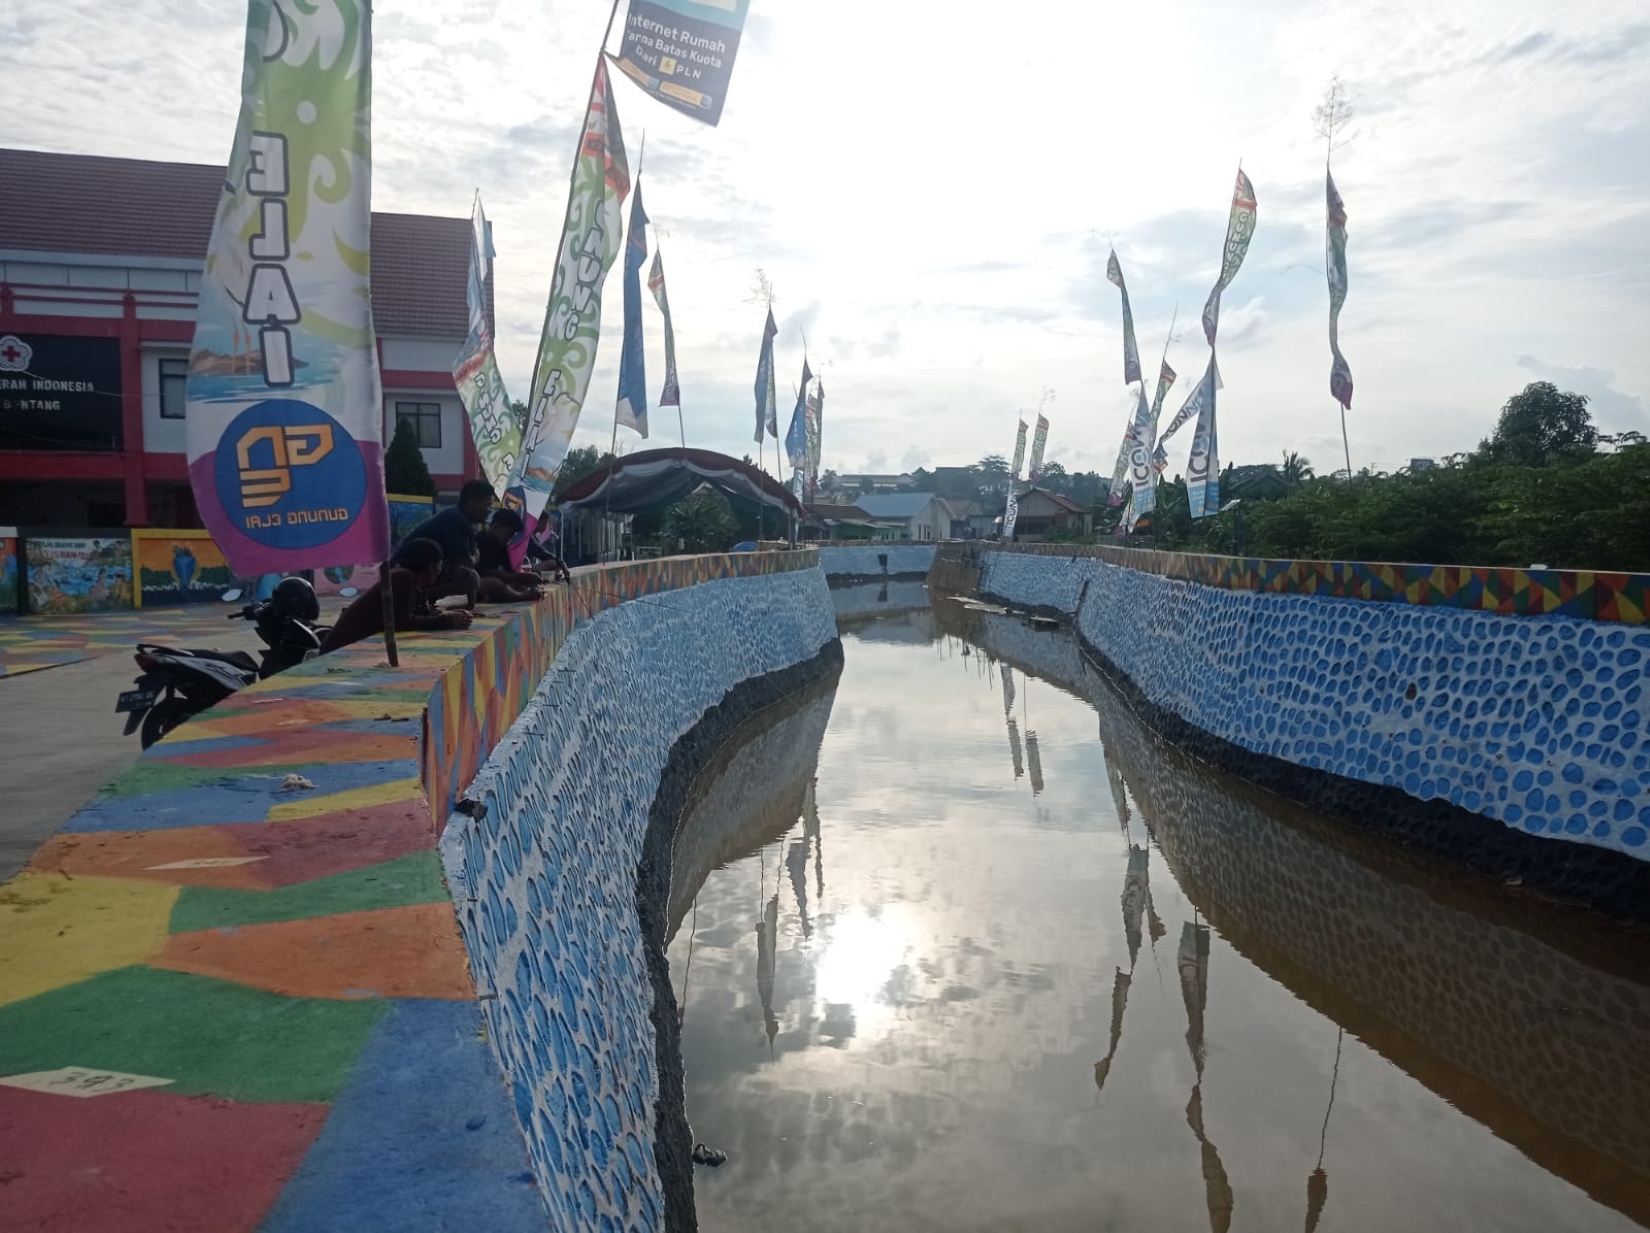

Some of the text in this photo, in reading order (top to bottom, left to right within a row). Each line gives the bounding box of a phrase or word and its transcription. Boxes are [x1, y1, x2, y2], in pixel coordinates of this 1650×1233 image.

[628, 13, 726, 54] Internet Rumah
[635, 45, 702, 79] Dari PLN
[655, 38, 687, 59] Batas
[688, 49, 722, 69] Kuota
[33, 379, 95, 393] INDONESIA
[3, 398, 61, 411] BNTANG
